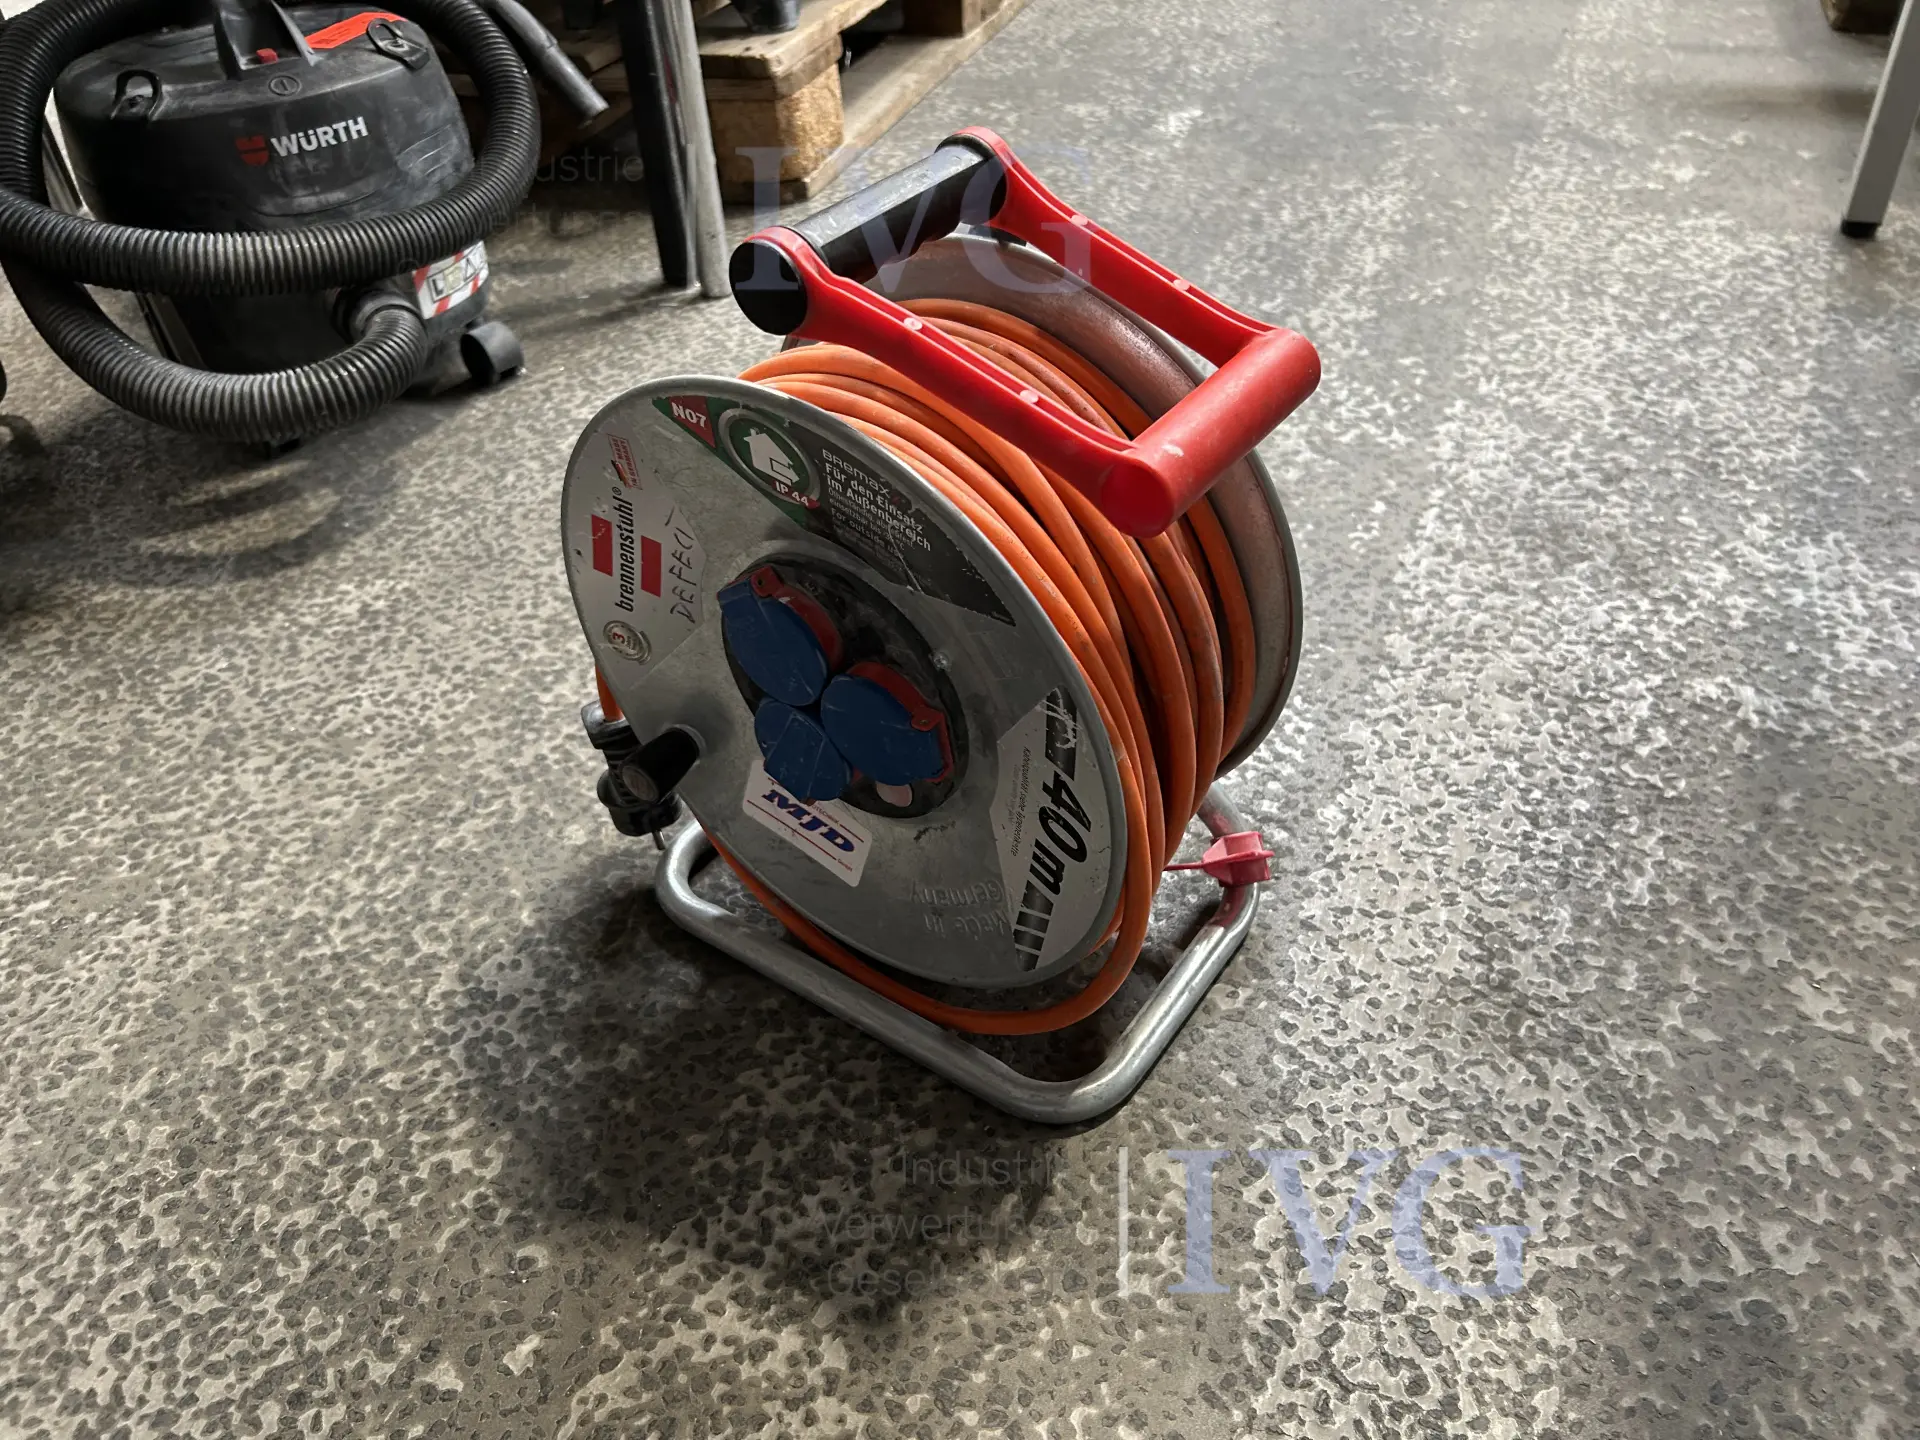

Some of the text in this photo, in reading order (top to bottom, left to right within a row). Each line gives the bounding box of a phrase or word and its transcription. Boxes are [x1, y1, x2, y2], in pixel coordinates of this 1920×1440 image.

[270, 116, 369, 157] WÜRTH
[775, 480, 809, 506] IP 44
[825, 463, 923, 534] Für den Einsatz
[827, 477, 842, 492] im
[846, 488, 931, 551] Außenbereich
[831, 507, 846, 521] For
[611, 631, 625, 645] 3
[761, 789, 855, 852] MJD
